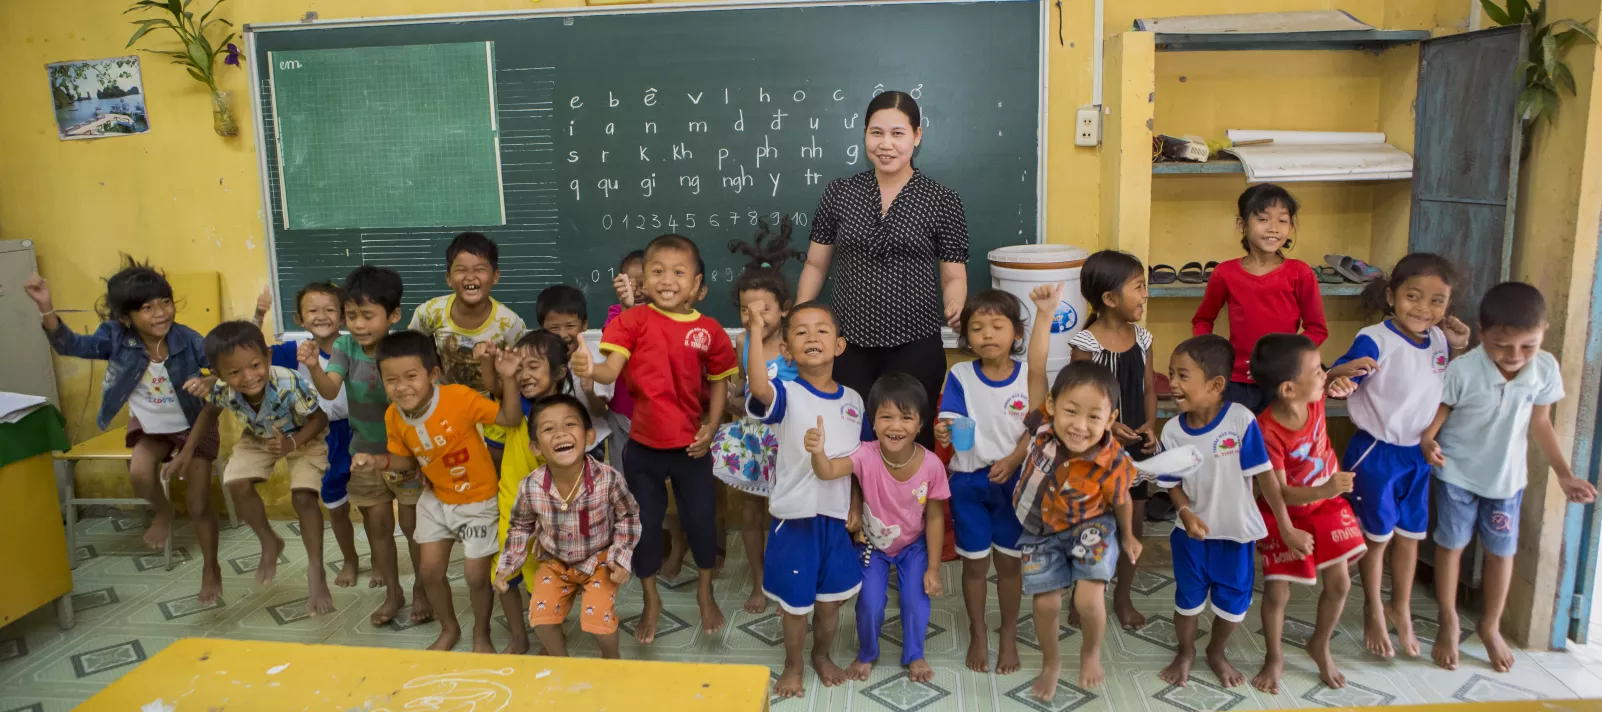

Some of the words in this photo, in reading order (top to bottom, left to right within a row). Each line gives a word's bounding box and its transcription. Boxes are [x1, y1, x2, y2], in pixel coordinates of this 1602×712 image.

[279, 60, 303, 71] em
[569, 95, 584, 109] e
[609, 91, 620, 107] b
[643, 87, 658, 106] ê
[687, 91, 703, 105] v
[759, 87, 771, 103] h
[793, 90, 806, 102] o
[832, 89, 845, 101] c
[569, 120, 575, 136] i
[605, 122, 615, 135] a
[645, 121, 657, 134] n
[688, 121, 708, 132] m
[734, 108, 744, 132] d
[770, 109, 789, 131] đ
[809, 117, 819, 130] u
[567, 150, 579, 163] s
[601, 150, 610, 163] r
[718, 148, 729, 171] p
[756, 134, 778, 169] ph
[801, 135, 823, 159] nh
[845, 144, 859, 166] g
[569, 179, 580, 201] q
[597, 178, 619, 198] qu
[640, 172, 656, 197] gi
[679, 174, 700, 195] ng
[722, 164, 754, 194] ngh
[769, 172, 781, 197] y
[804, 168, 823, 186] tr
[622, 214, 629, 229] 1
[635, 214, 646, 230] 2
[651, 213, 662, 229] 3
[668, 214, 679, 234] 4
[685, 213, 697, 228] 5
[709, 213, 720, 227] 6
[729, 211, 741, 226] 7
[747, 210, 759, 226] 8
[769, 211, 780, 226] 9
